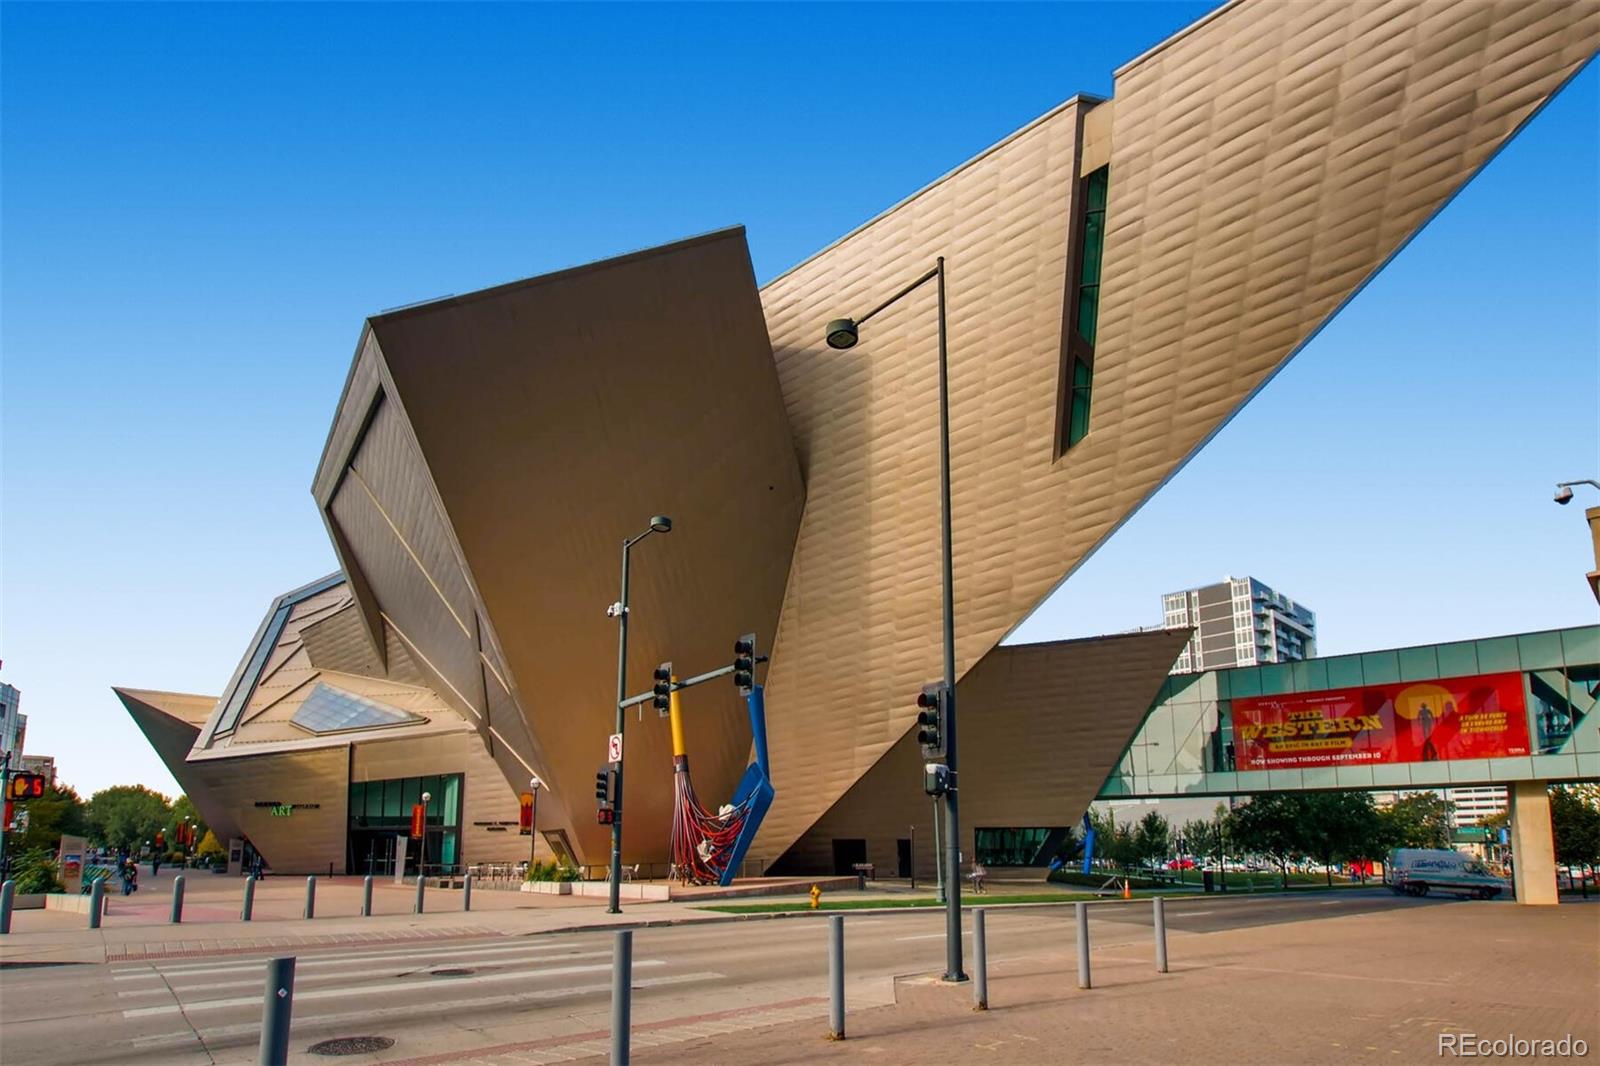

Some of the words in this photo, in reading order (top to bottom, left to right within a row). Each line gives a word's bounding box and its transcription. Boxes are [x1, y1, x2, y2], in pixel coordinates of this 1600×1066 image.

[1288, 710, 1323, 720] THE
[1240, 715, 1382, 739] WESTERN
[1250, 758, 1265, 766] NOW
[1266, 756, 1298, 764] SHOWING
[1298, 755, 1331, 763] THROUGH
[1332, 752, 1373, 761] SEPTEMBER
[272, 805, 292, 817] ART
